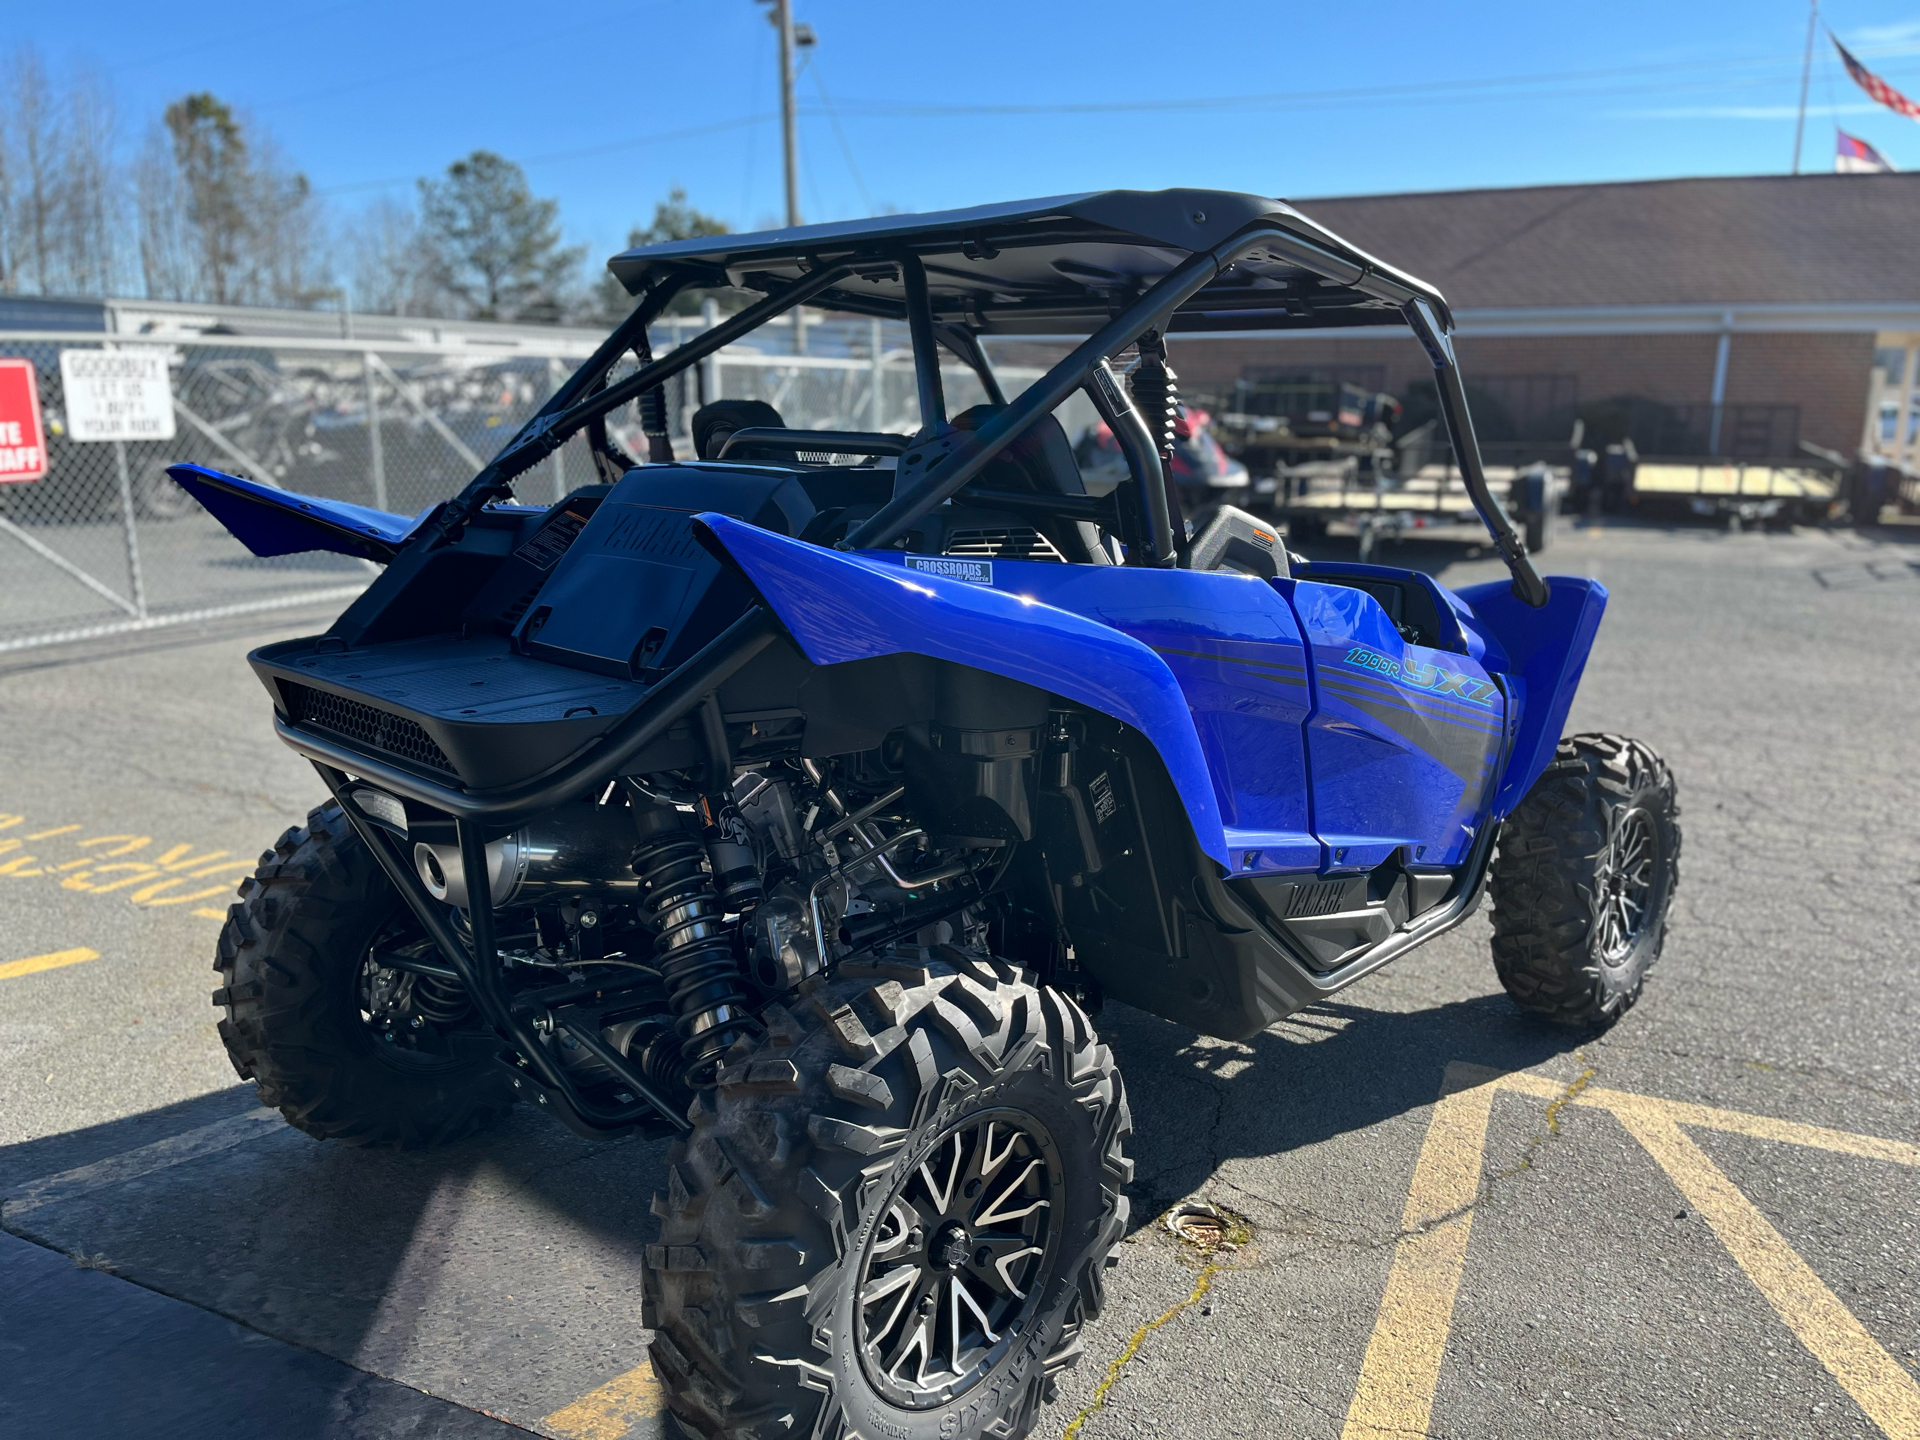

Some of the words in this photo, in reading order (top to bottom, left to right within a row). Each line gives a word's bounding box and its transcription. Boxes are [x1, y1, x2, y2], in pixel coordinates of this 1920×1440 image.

[916, 560, 981, 577] CROSSROADS
[1344, 647, 1400, 680] 1000R
[1401, 658, 1497, 708] YXZ
[1284, 881, 1348, 917] YAMAHA
